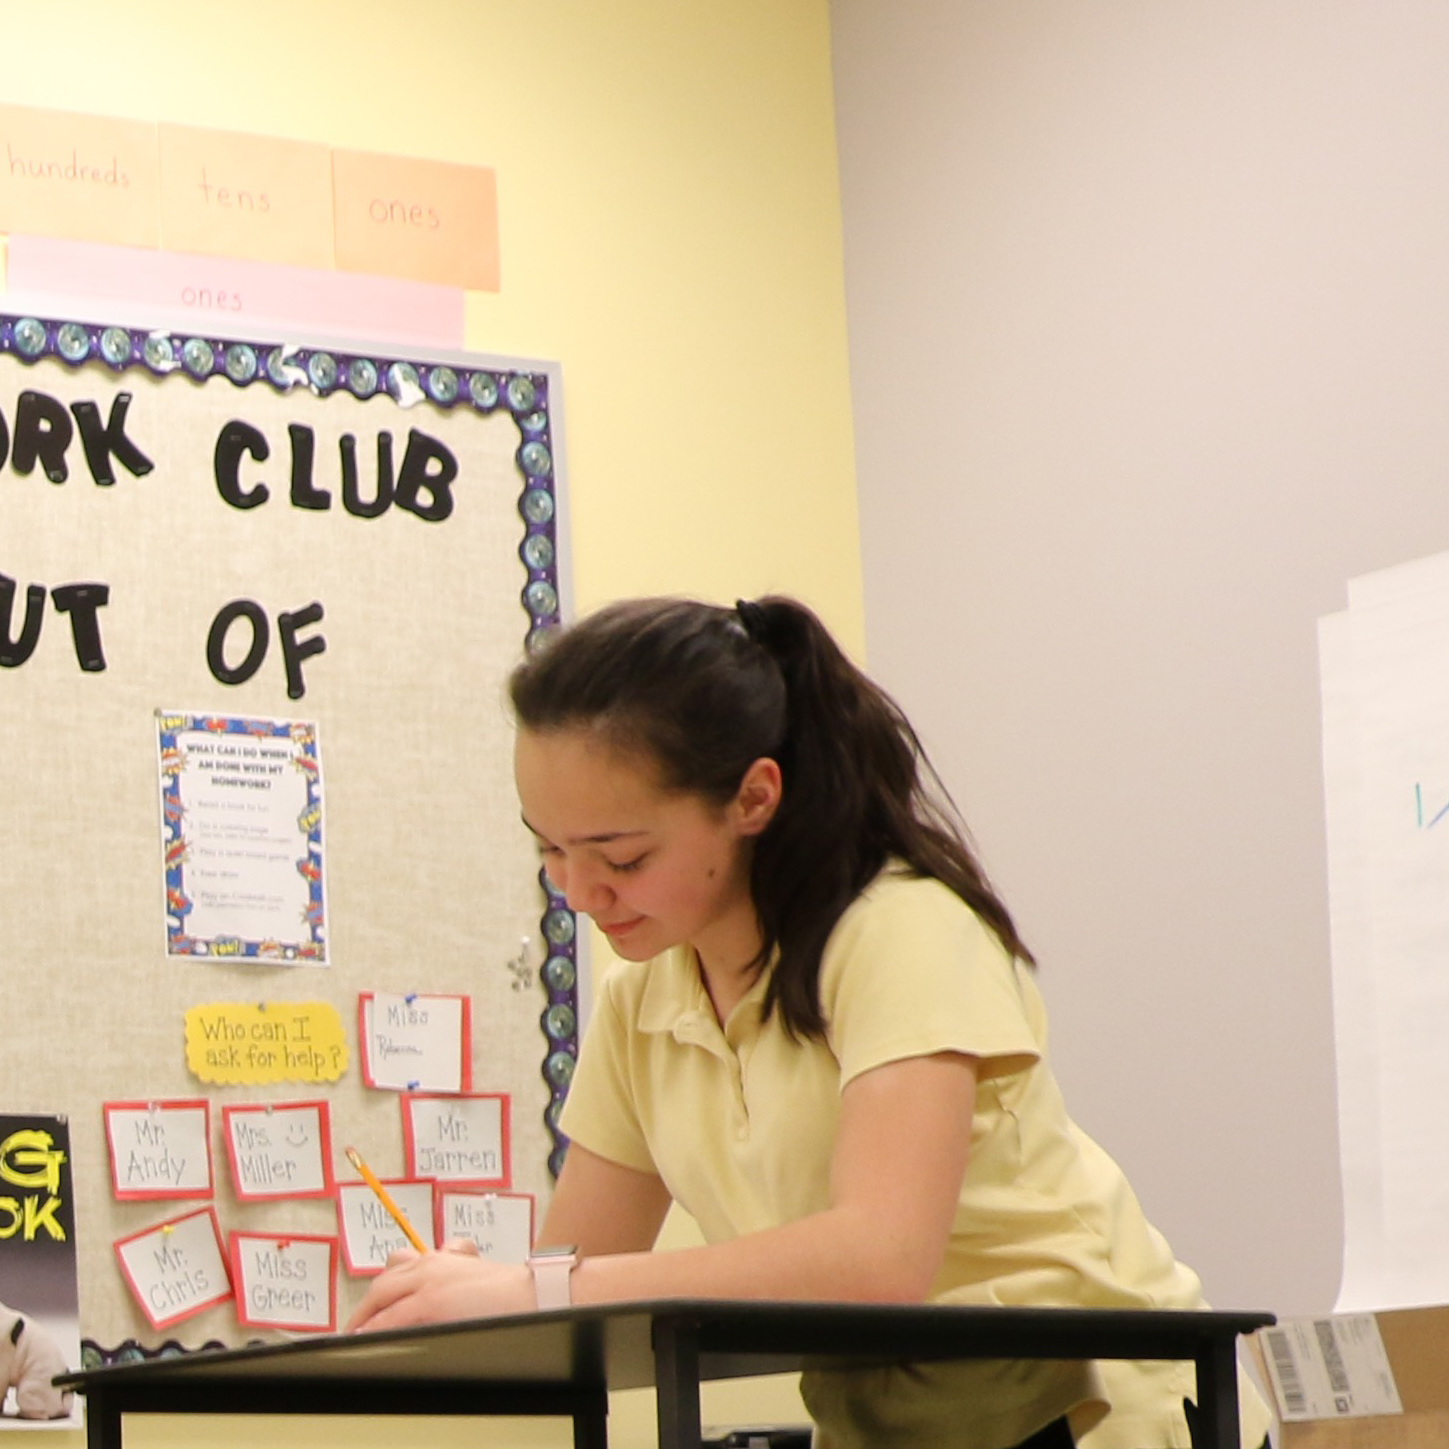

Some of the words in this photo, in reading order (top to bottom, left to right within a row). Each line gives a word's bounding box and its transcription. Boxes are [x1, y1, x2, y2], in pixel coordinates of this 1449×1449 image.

[6, 146, 131, 190] hundreds
[198, 176, 272, 213] tens
[368, 192, 441, 230] ones
[180, 284, 244, 312] ones
[214, 420, 458, 521] CLUB
[205, 599, 327, 699] OF
[186, 744, 214, 755] WHAT
[243, 748, 257, 757] DO
[242, 763, 266, 775] WITH
[200, 1016, 246, 1042] Who
[251, 1023, 288, 1042] can
[293, 1016, 311, 1042] I
[388, 1005, 428, 1027] Miss
[206, 1044, 241, 1068] ask
[247, 1044, 277, 1068] for
[135, 1120, 166, 1147] Mr.
[236, 1123, 273, 1149] Mrs.
[438, 1115, 468, 1142] Mr.
[127, 1150, 185, 1183] Andy
[242, 1154, 297, 1184] Miller
[420, 1147, 497, 1171] Jarren
[155, 1243, 189, 1275] Mr.
[257, 1252, 307, 1280] Miss
[149, 1269, 210, 1311] Chris
[252, 1284, 316, 1312] Greer
